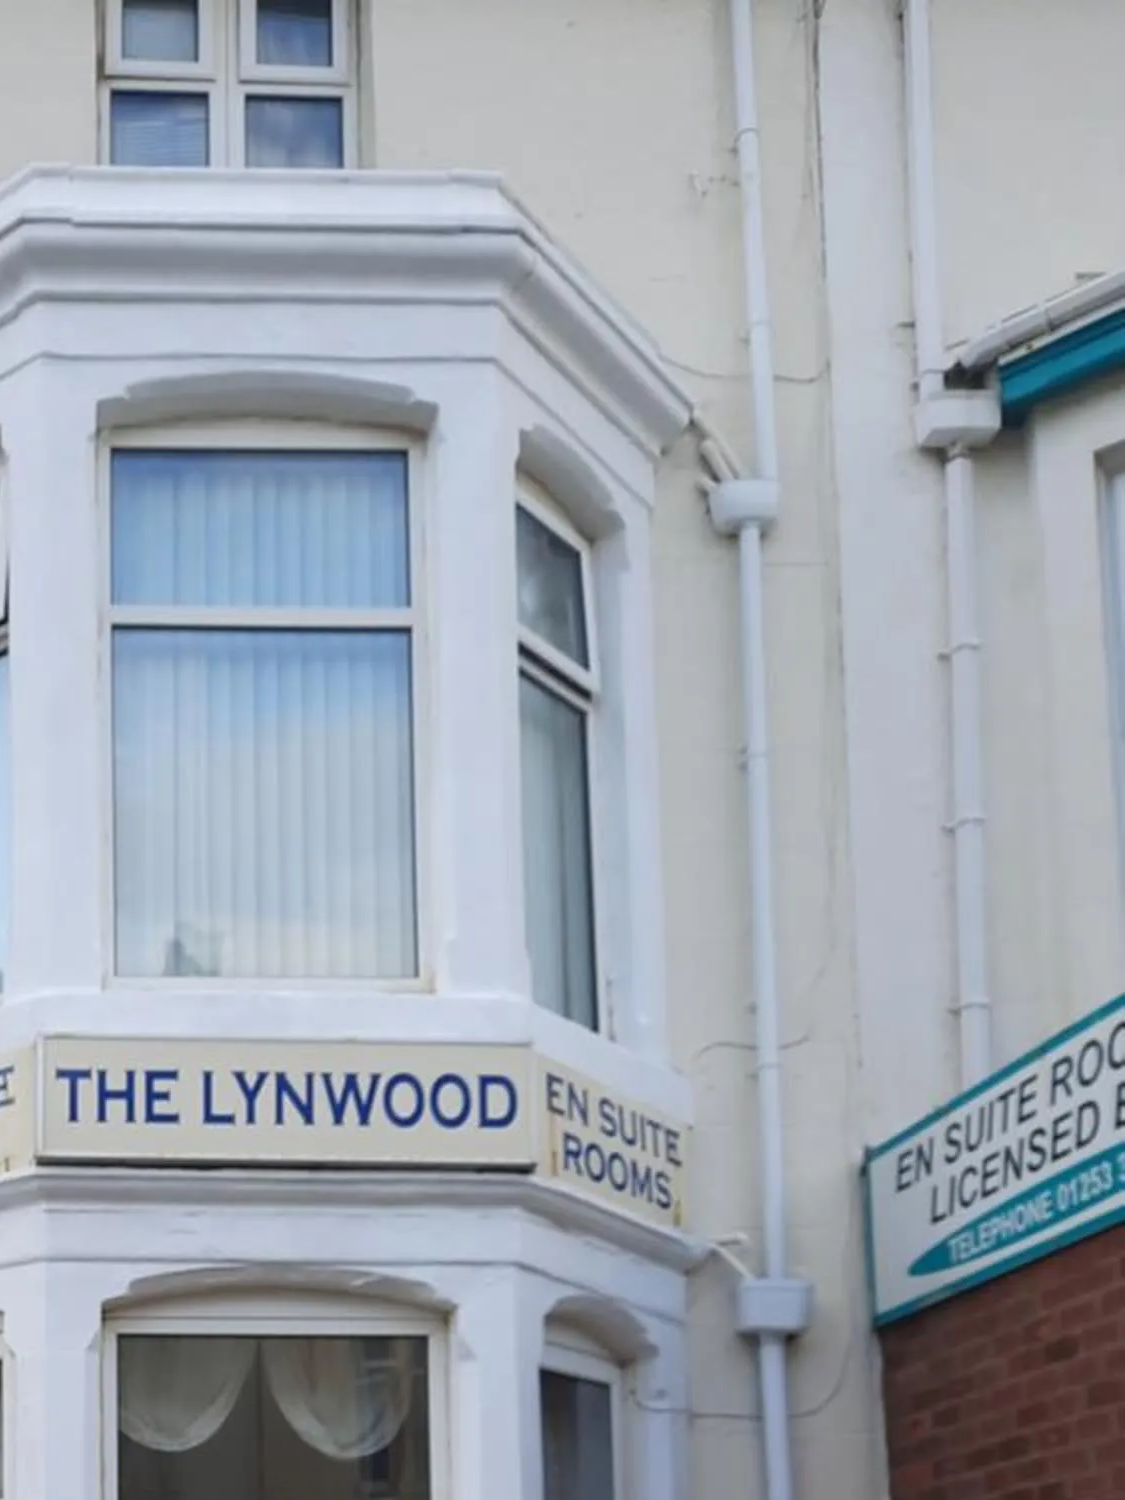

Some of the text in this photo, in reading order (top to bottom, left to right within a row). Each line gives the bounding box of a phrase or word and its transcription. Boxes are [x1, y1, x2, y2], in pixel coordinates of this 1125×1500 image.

[55, 1068, 518, 1128] THE LYNWOOD
[545, 1072, 682, 1167] EN SUITE
[895, 1136, 935, 1193] EN
[944, 1073, 1038, 1165] SUITE
[562, 1132, 672, 1209] ROOMS
[930, 1100, 1101, 1225] LICENSED
[947, 1188, 1054, 1263] TELEPHONE
